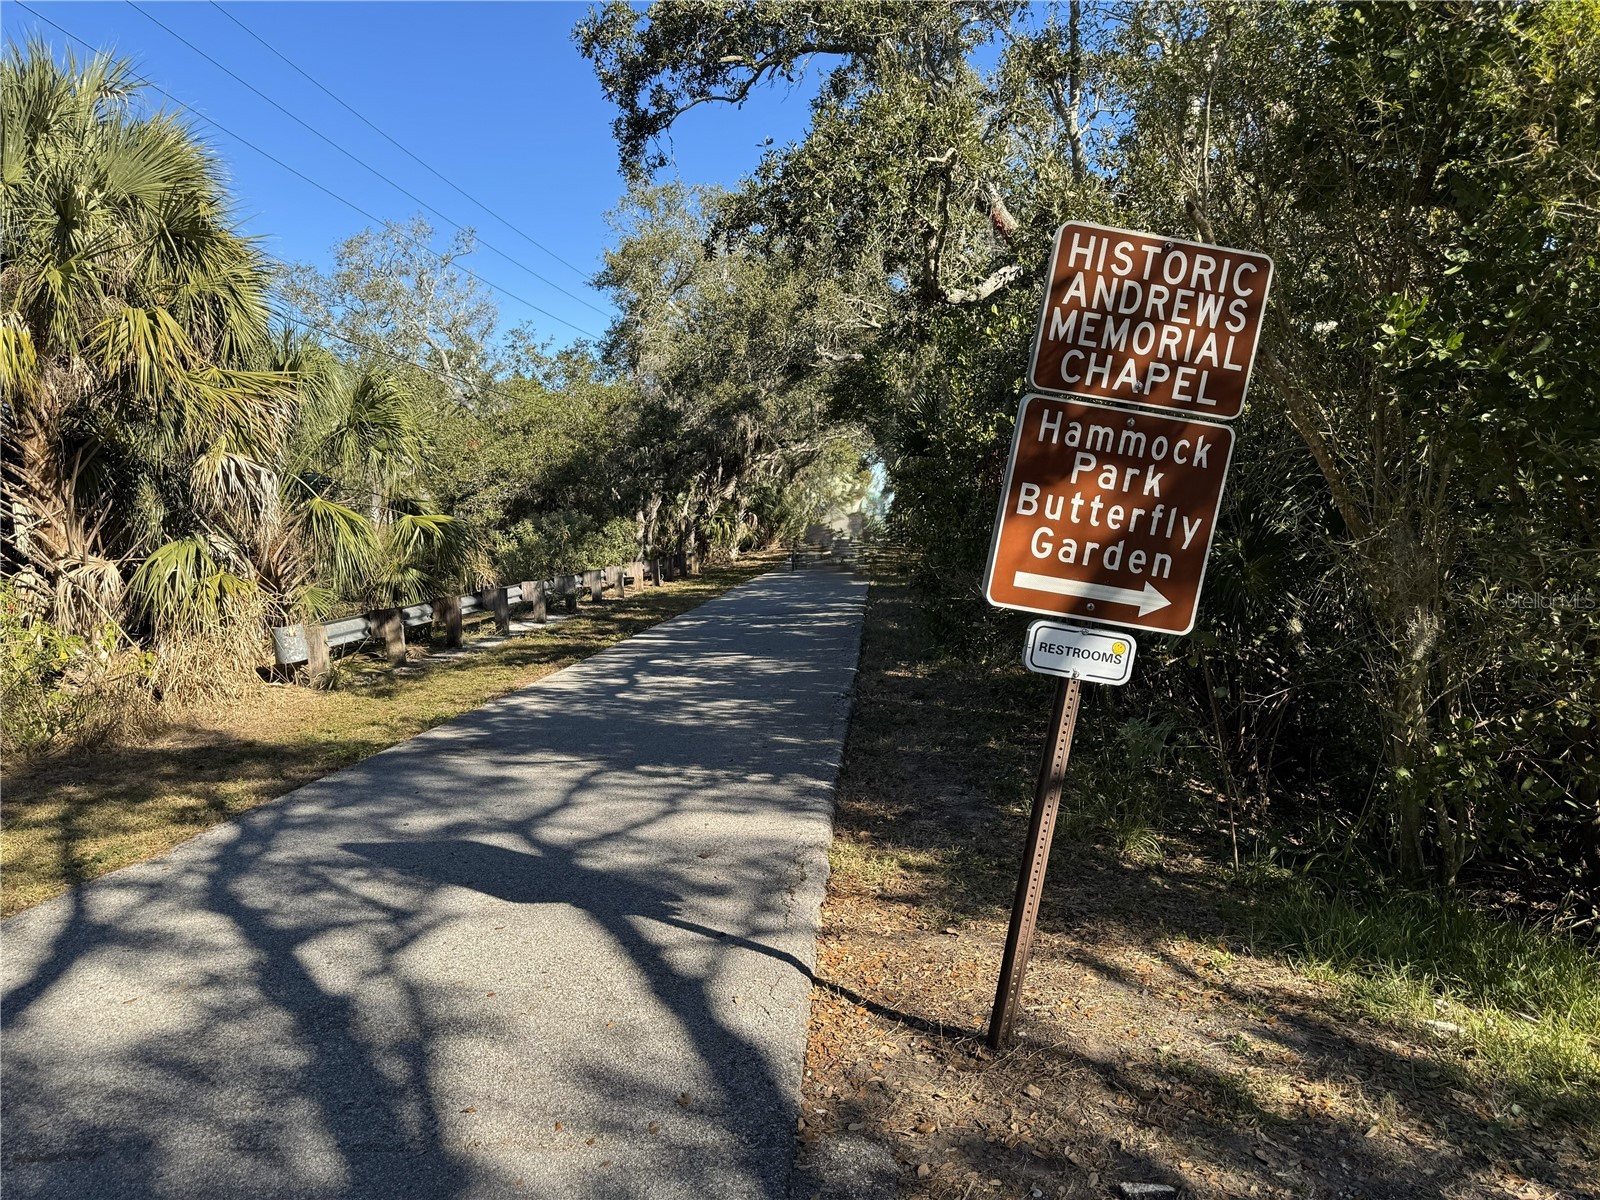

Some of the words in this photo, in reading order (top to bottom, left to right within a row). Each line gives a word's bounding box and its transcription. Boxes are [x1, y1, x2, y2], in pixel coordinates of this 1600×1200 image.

[1067, 232, 1258, 297] HISTORIC
[1061, 271, 1249, 333] ANDREWS
[1048, 306, 1243, 372] MEMORIAL
[1060, 349, 1217, 406] CHAPEL
[1038, 408, 1212, 469] Hammock
[1069, 451, 1165, 498] Park
[1016, 482, 1202, 550] Butterfly
[1030, 526, 1172, 579] Garden
[1038, 641, 1122, 666] RESTROOMS
